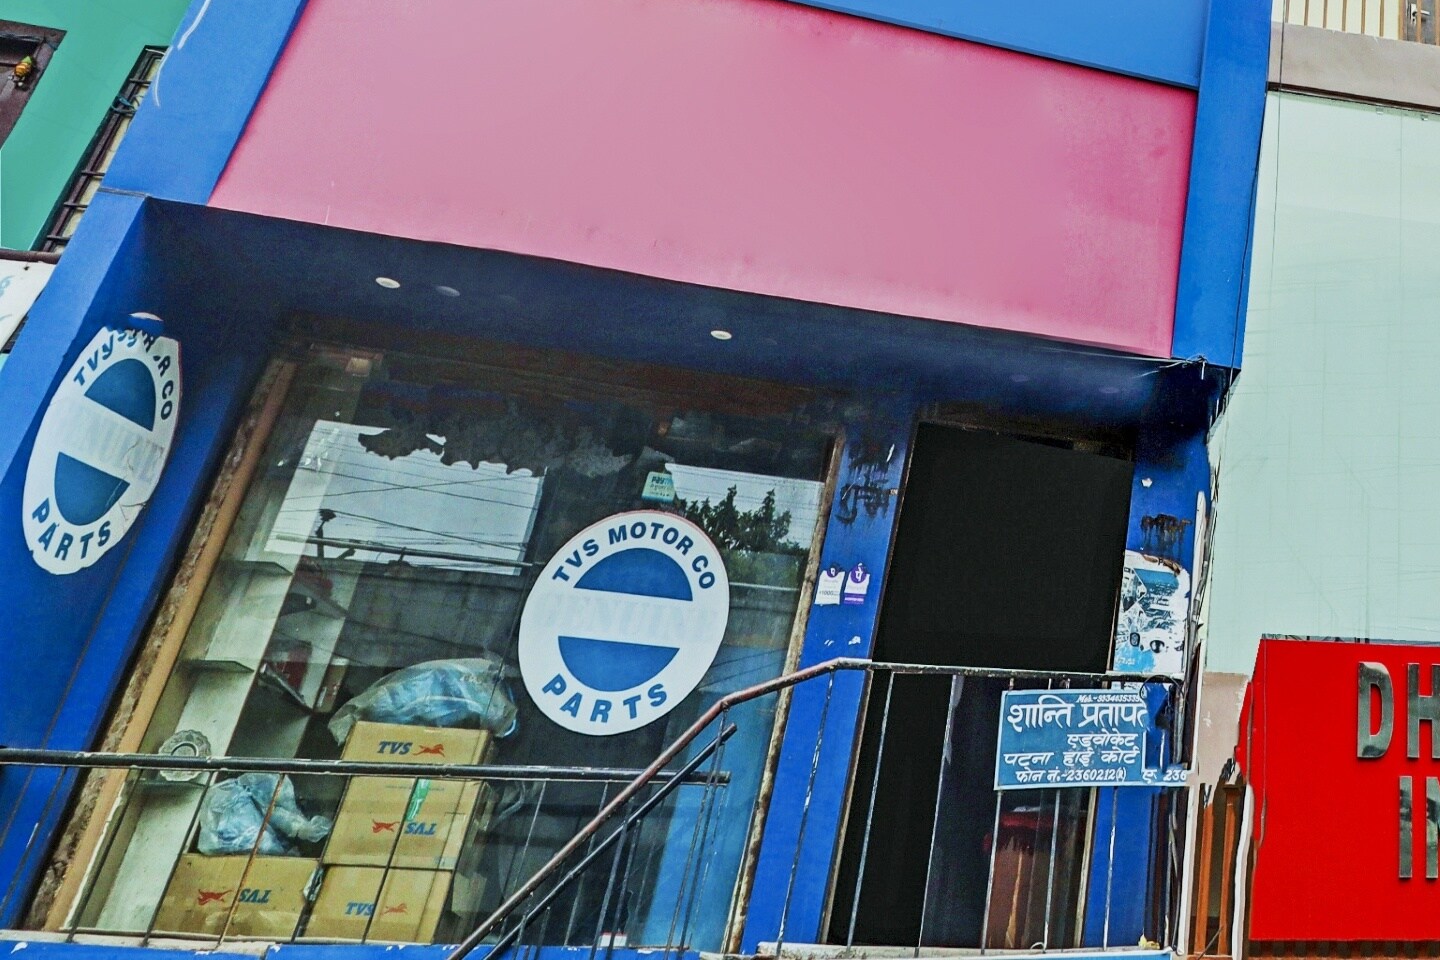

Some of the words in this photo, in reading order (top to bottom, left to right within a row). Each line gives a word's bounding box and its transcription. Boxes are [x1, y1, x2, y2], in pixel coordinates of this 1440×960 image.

[32, 497, 111, 561] PARTS
[552, 538, 600, 582] TVS
[608, 521, 694, 556] MOTOR
[692, 554, 716, 590] CO
[542, 673, 668, 723] PARTS
[377, 741, 413, 755] TVS
[1003, 751, 1054, 767] पटना
[1063, 747, 1095, 767] हाई
[1101, 746, 1140, 764] कोर्ट
[1016, 767, 1043, 782] फोन
